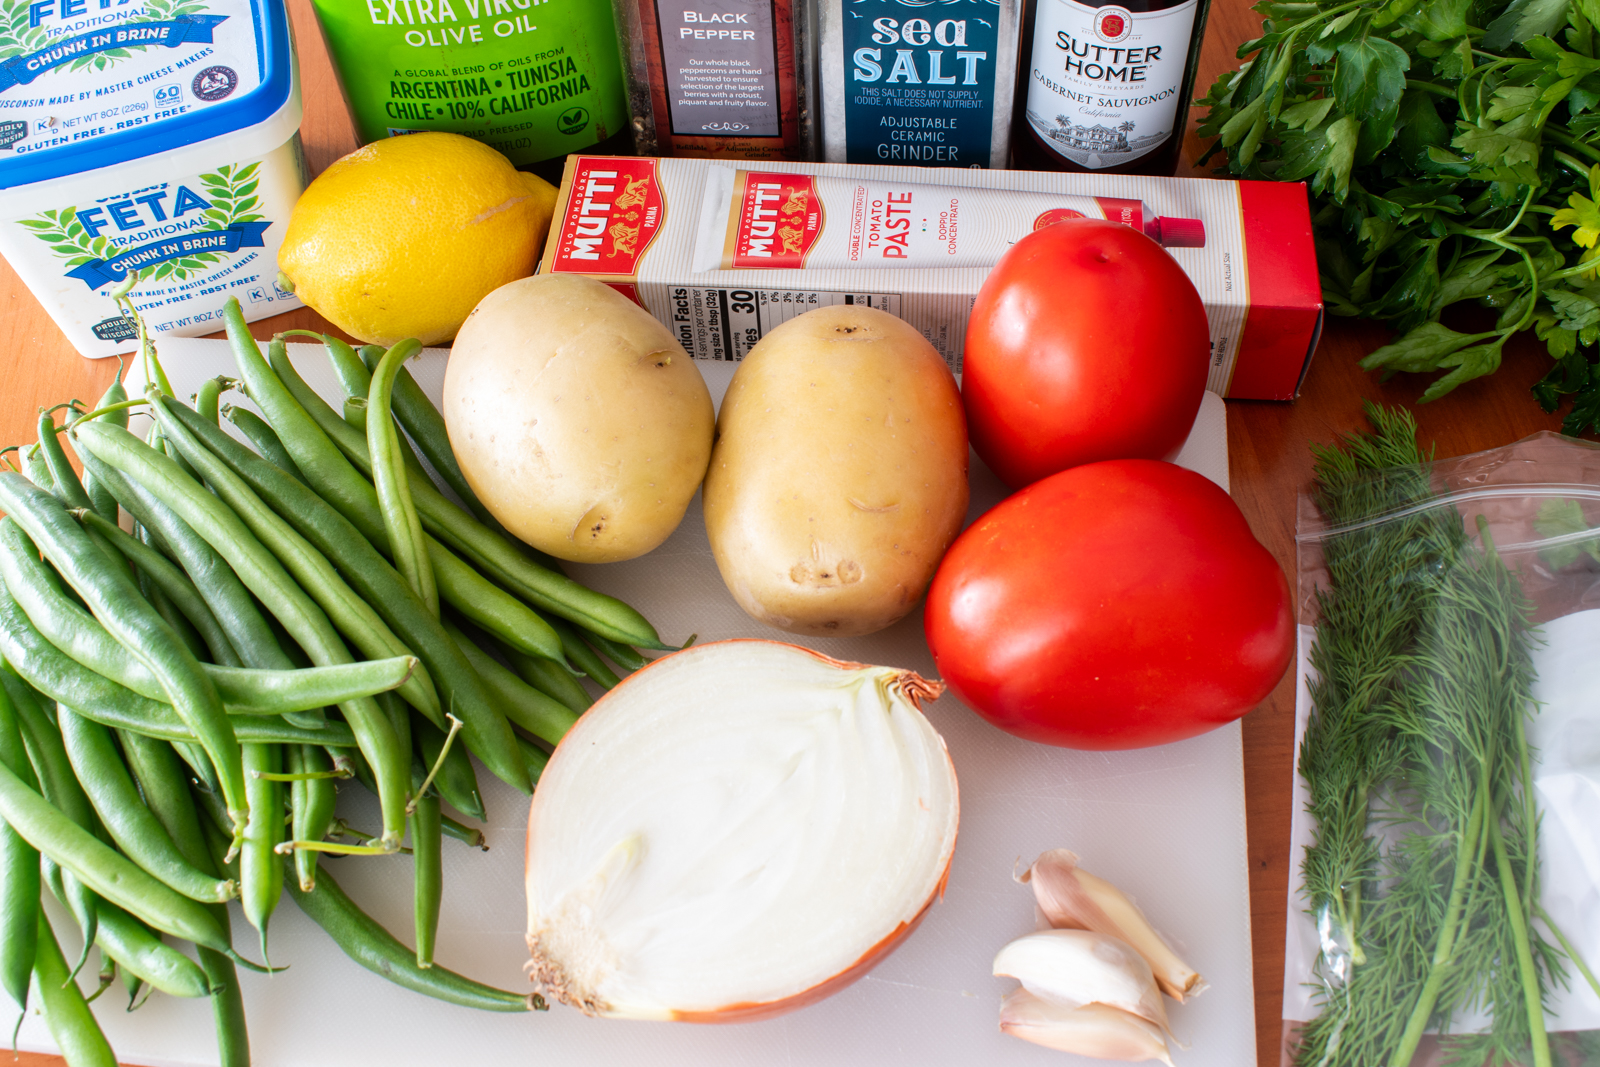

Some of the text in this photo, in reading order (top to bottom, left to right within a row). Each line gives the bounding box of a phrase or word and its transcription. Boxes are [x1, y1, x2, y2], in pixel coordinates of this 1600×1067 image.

[46, 7, 150, 39] TRADITIONAL
[367, 0, 458, 25] EXTRA
[404, 14, 537, 47] OLIVE OIL
[871, 17, 968, 47] sea
[27, 27, 170, 71] CHUNK IN BRINE
[1055, 30, 1162, 64] SUTTER
[393, 46, 565, 78] A GLOBAL BLEND OF OILS FROM
[679, 67, 728, 75] peppercorns
[853, 47, 986, 85] SALT
[1064, 55, 1149, 82] HOME
[0, 47, 214, 108] ISCONSIN MADE BY MASTER CHEESE MAKERS
[390, 55, 578, 99] ARGENTINA TUNISIA
[738, 84, 764, 92] largest
[1033, 68, 1176, 108] CABERNET SAUVIGNON
[1064, 74, 1093, 87] FAMILY
[155, 86, 180, 99] 60
[385, 74, 591, 120] CHILE 10% CALIFORNIA
[678, 99, 708, 107] piquant
[724, 99, 745, 108] fruity
[745, 99, 770, 107] flavor.
[854, 95, 984, 109] IODIDE, A NECESSARY NUTRIENT.
[861, 87, 979, 100] THIS SALT DOES NOT SUPPLY
[62, 117, 82, 129] NET
[83, 113, 98, 123] WT
[121, 101, 149, 115] (226g)
[879, 116, 957, 129] ADJUSTABLE
[1078, 106, 1122, 119] California
[17, 135, 69, 153] GLUTEN
[73, 126, 106, 140] FREE
[116, 115, 150, 130] RBST
[38, 121, 47, 130] K
[489, 121, 533, 136] PRESSED
[565, 124, 586, 135] VEGAN
[891, 130, 945, 142] CERAMIC
[877, 143, 959, 161] GRINDER
[75, 185, 213, 238] FETA
[570, 170, 619, 260] MUTTI
[644, 206, 658, 228] PARMA
[747, 182, 783, 257] MUTTI
[807, 212, 818, 231] PARMA
[851, 185, 865, 261] DOUBLE CONCENTRATED
[868, 199, 883, 248] TOMATO
[110, 216, 209, 248] TRADITIONAL
[882, 192, 912, 259] PASTE
[939, 211, 948, 241] DOPPIO
[948, 198, 959, 255] CONCENTRATO
[111, 235, 227, 273] CHUNK IN BRINE
[562, 233, 573, 259] SOLO
[741, 234, 749, 256] SOLO
[101, 251, 259, 298] WINSIN MADE BY MASTER CHEESE MAKERS
[1224, 264, 1232, 280] Actual
[121, 298, 164, 315] GUTEN
[165, 293, 193, 305] FREE
[200, 284, 228, 297] RBST
[251, 290, 262, 299] K
[674, 288, 689, 321] Facts
[692, 288, 704, 317] container
[705, 288, 718, 310] (32g)
[730, 290, 755, 314] 30
[771, 291, 780, 303] 0%
[783, 292, 792, 303] 3%
[796, 293, 805, 304] 2%
[808, 293, 817, 304] 5%
[95, 318, 136, 332] PROUDY
[155, 321, 174, 333] NET
[175, 317, 192, 327] WT
[695, 317, 707, 328] per
[708, 309, 720, 326] tbsp
[100, 328, 137, 339] WISCONS
[696, 328, 708, 352] servings
[710, 332, 721, 347] size
[733, 332, 741, 349] serving
